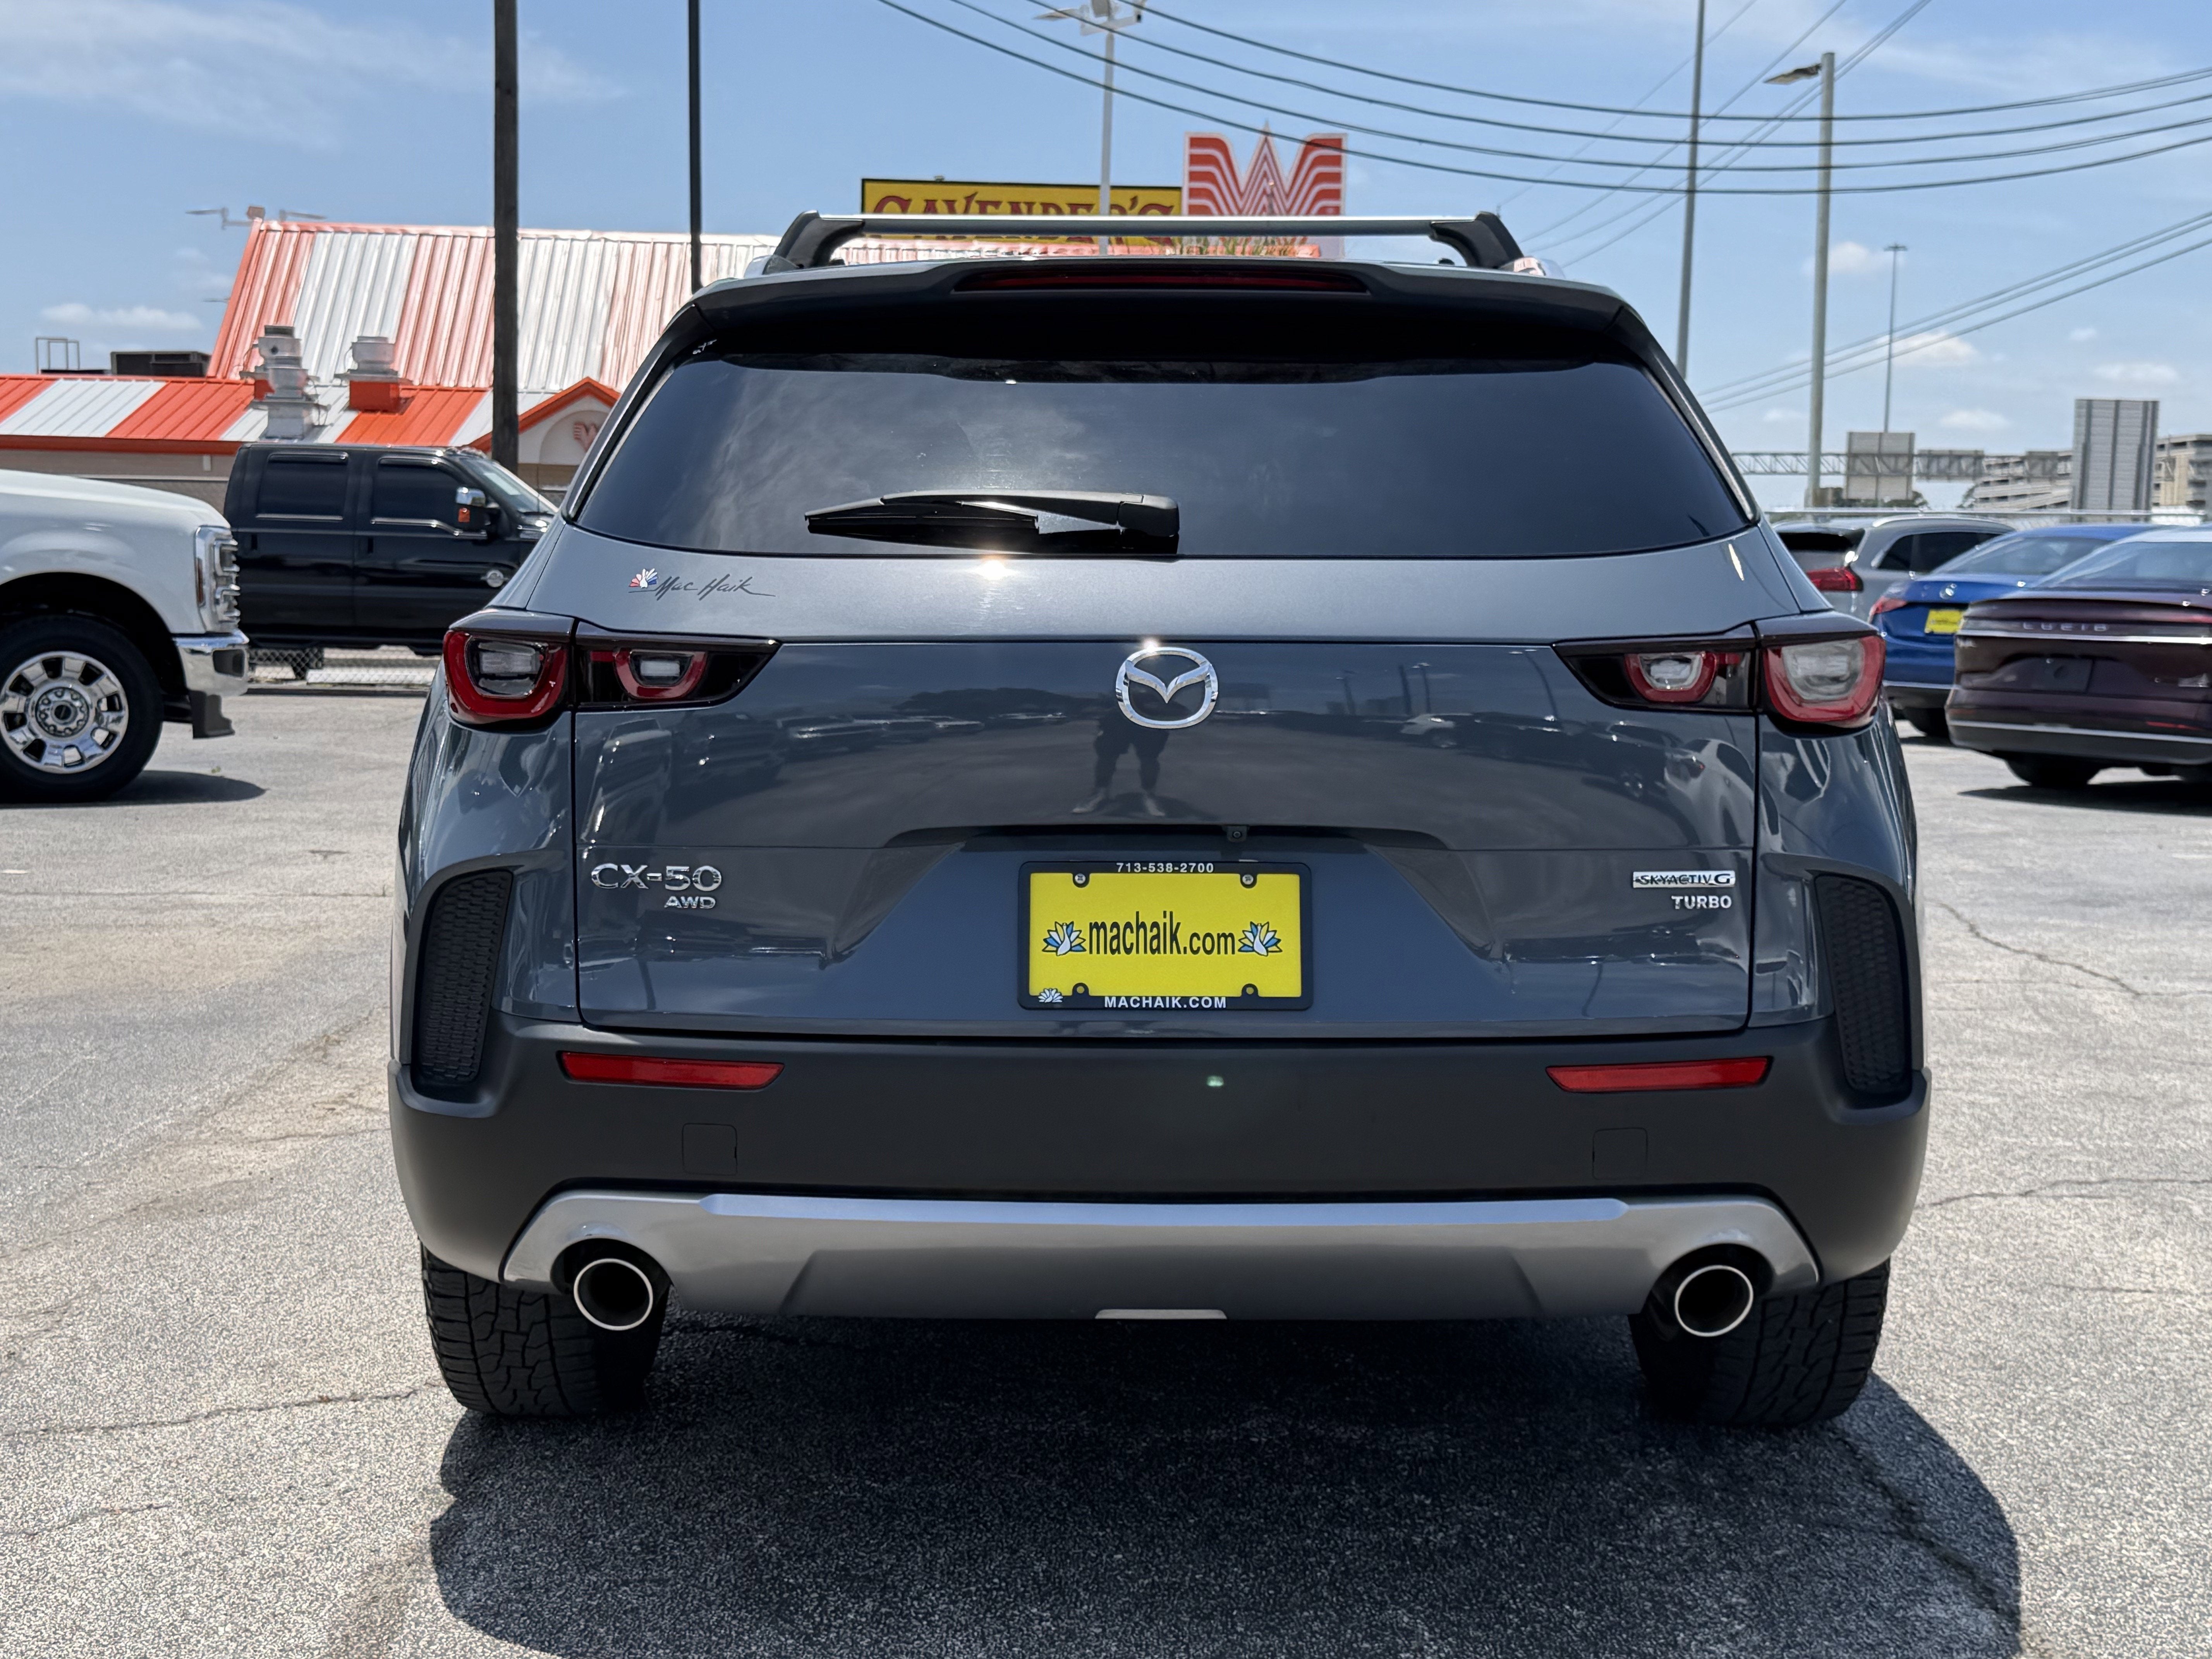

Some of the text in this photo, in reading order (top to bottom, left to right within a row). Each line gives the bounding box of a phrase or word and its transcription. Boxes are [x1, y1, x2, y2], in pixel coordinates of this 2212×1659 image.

[629, 574, 776, 601] Mac Haik
[1116, 862, 1214, 873] 713-538-2700
[591, 863, 722, 891] CX-50
[664, 896, 716, 909] AWD
[1671, 895, 1732, 909] TURBO
[1089, 910, 1236, 955] machaik.com
[1104, 996, 1227, 1008] MACHAIK.COM
